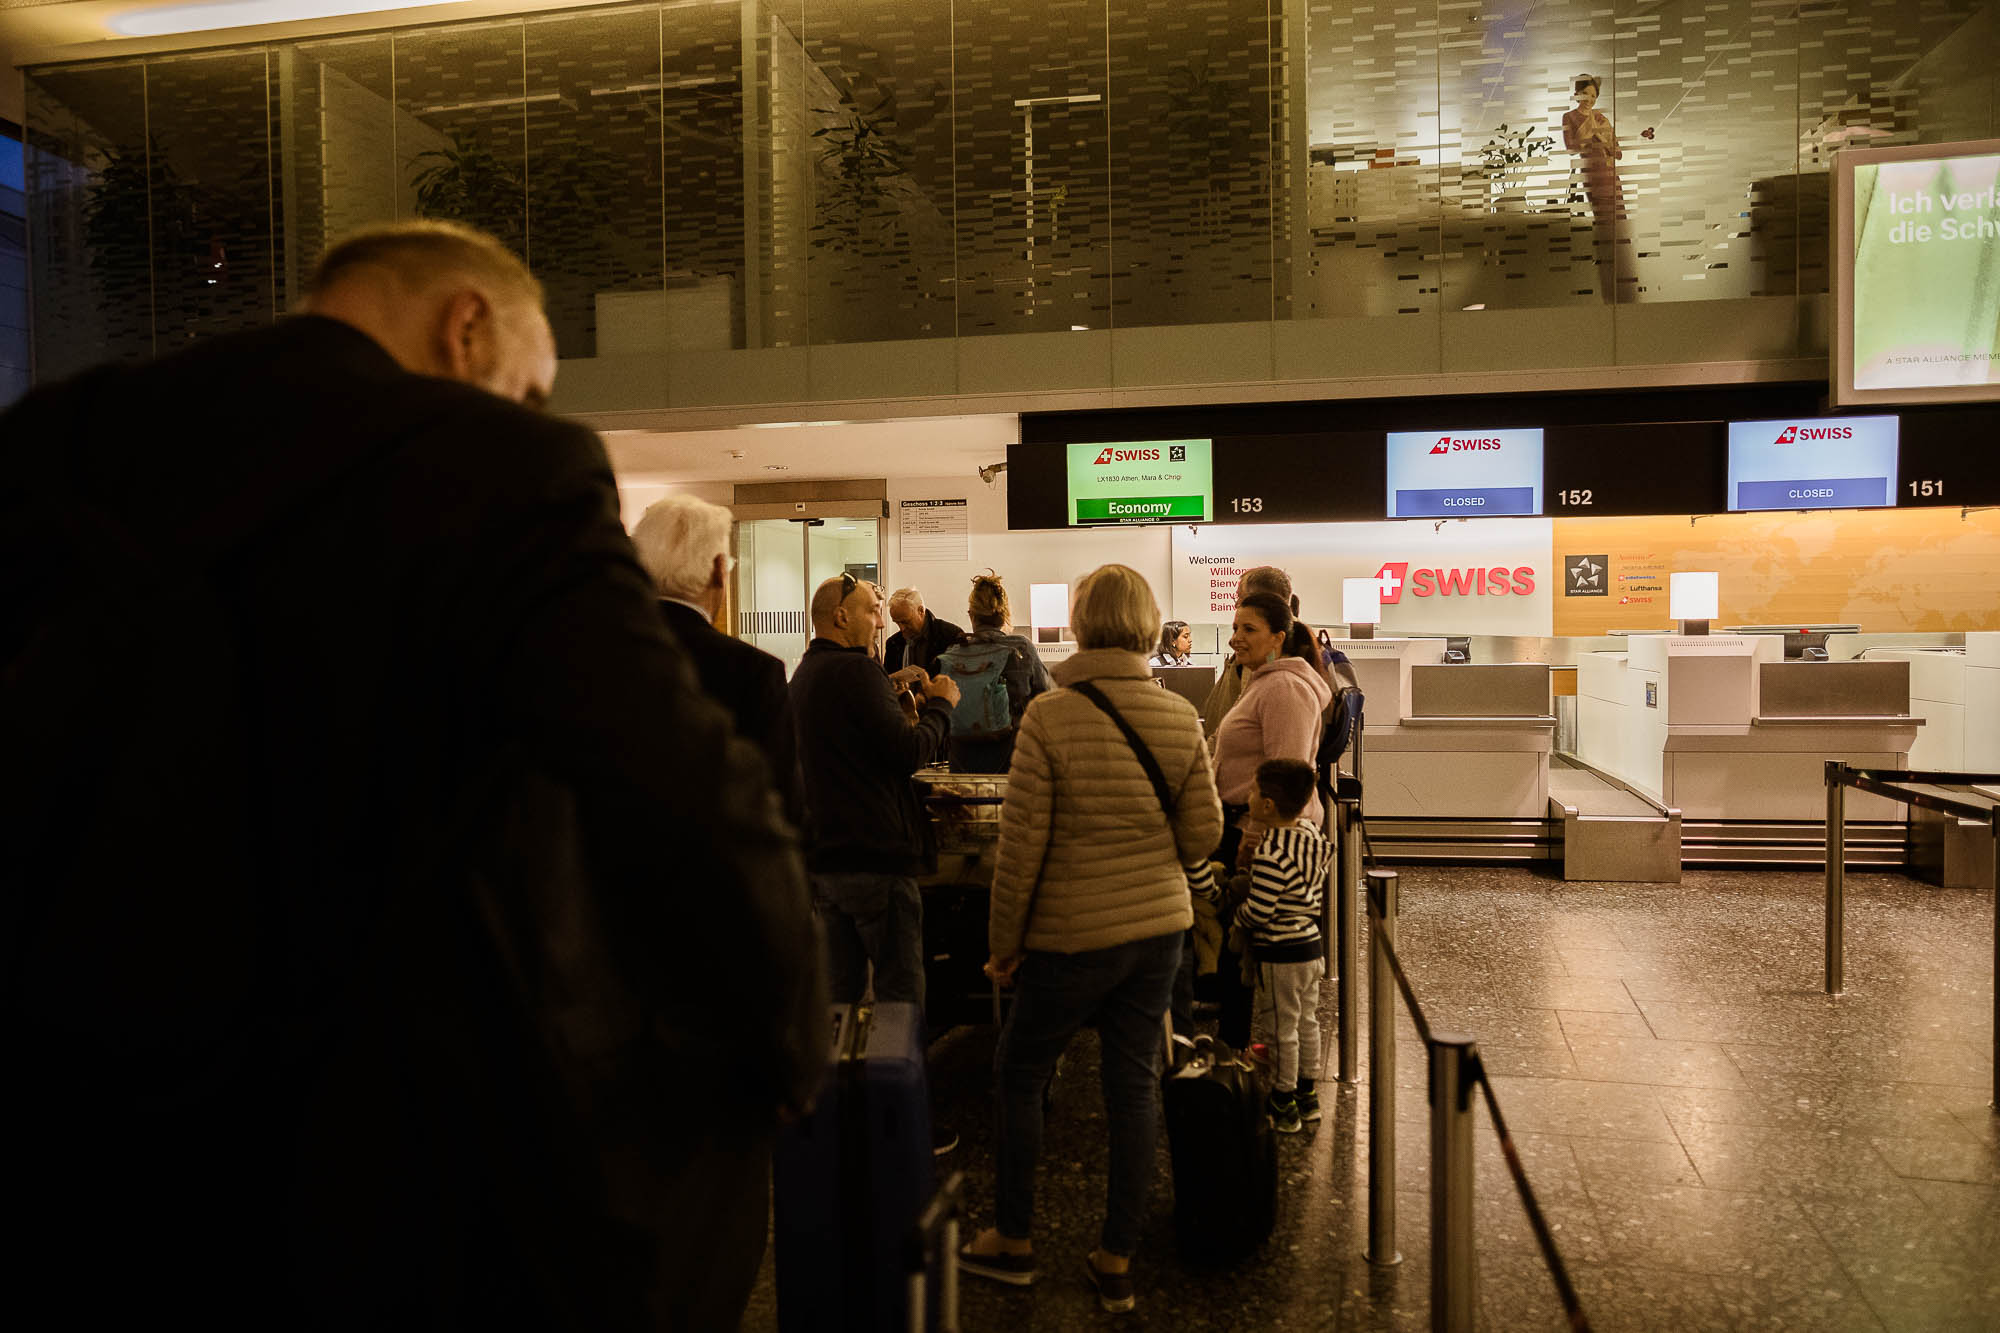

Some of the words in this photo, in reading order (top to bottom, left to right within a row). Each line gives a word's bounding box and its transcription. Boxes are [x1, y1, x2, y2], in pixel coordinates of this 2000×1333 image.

[1889, 190, 1932, 214] Ich
[1888, 220, 1932, 244] die
[1886, 357, 1893, 365] A
[1895, 356, 1920, 365] STAR
[1922, 354, 1971, 363] ALLIANCE
[1800, 427, 1853, 440] SWISS
[1452, 439, 1501, 451] SWISS
[1114, 449, 1160, 462] SWISS
[1789, 488, 1834, 498] CLOSED
[1908, 480, 1943, 496] 151
[1443, 497, 1485, 507] CLOSED
[1558, 490, 1592, 505] 152
[1108, 502, 1172, 515] Economy
[1231, 497, 1263, 512] 153
[1188, 556, 1235, 564] Welcome
[1210, 579, 1239, 588] Bienv
[1412, 567, 1535, 597] SWISS
